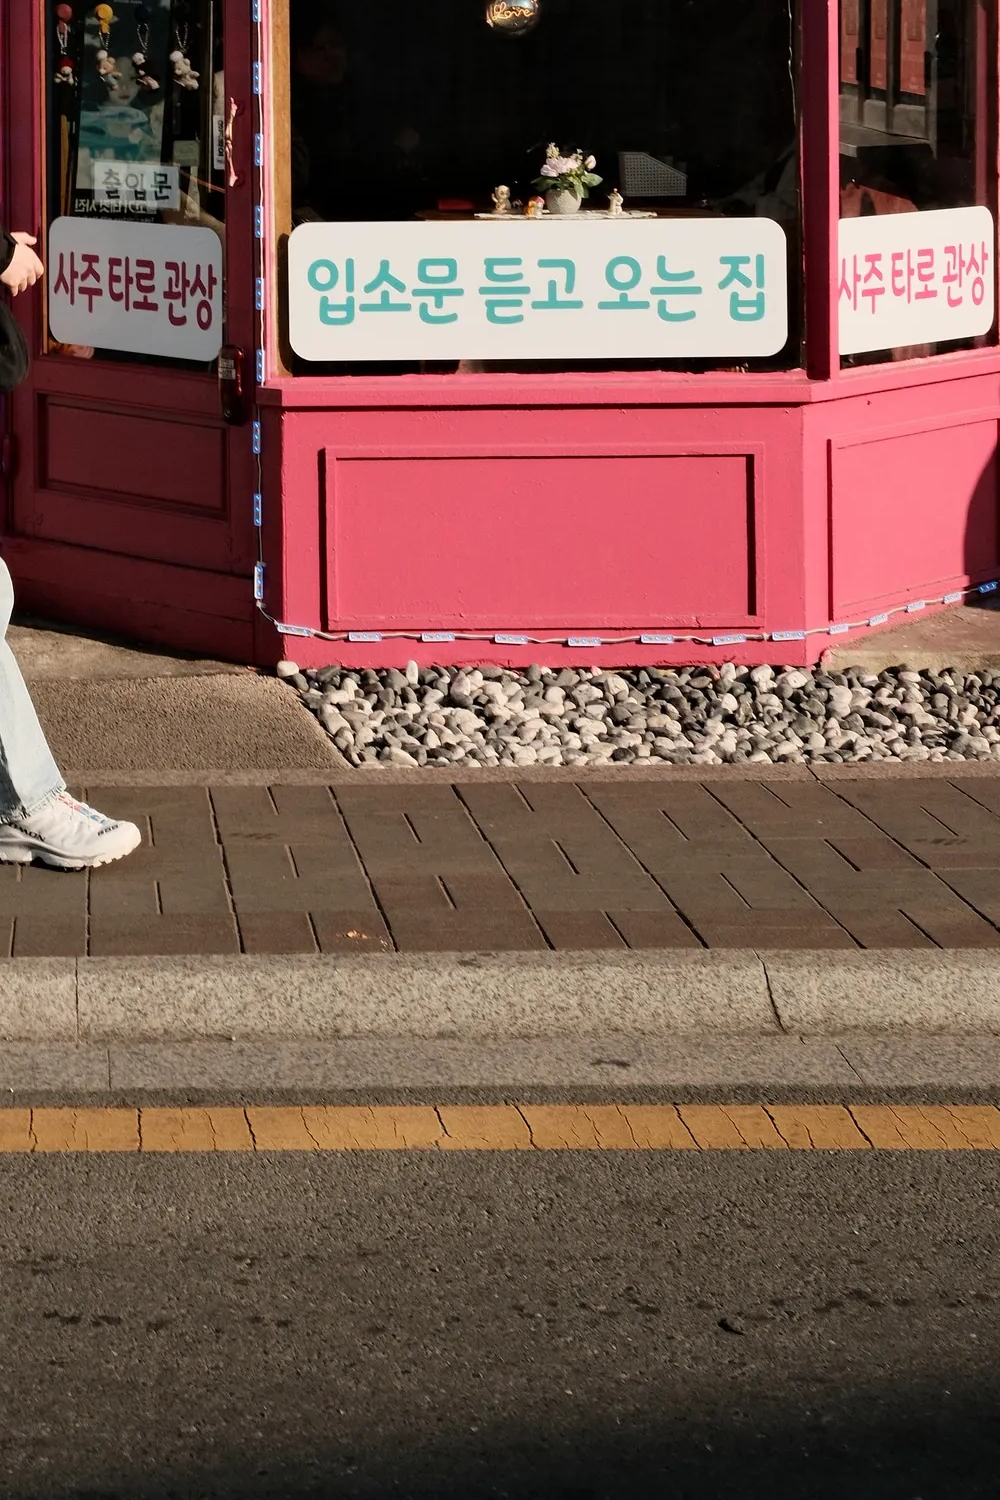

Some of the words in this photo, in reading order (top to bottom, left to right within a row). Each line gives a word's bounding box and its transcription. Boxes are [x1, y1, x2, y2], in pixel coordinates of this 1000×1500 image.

[102, 168, 172, 201] 출입문
[53, 251, 103, 314] 사주
[108, 256, 159, 312] 타로
[162, 261, 218, 332] 관상
[308, 258, 464, 325] 입소문
[479, 257, 583, 324] 듣고
[598, 255, 702, 322] 오는
[718, 254, 766, 322] 집
[838, 253, 886, 315] 사주
[891, 248, 938, 305] 타로
[942, 241, 989, 308] 관상
